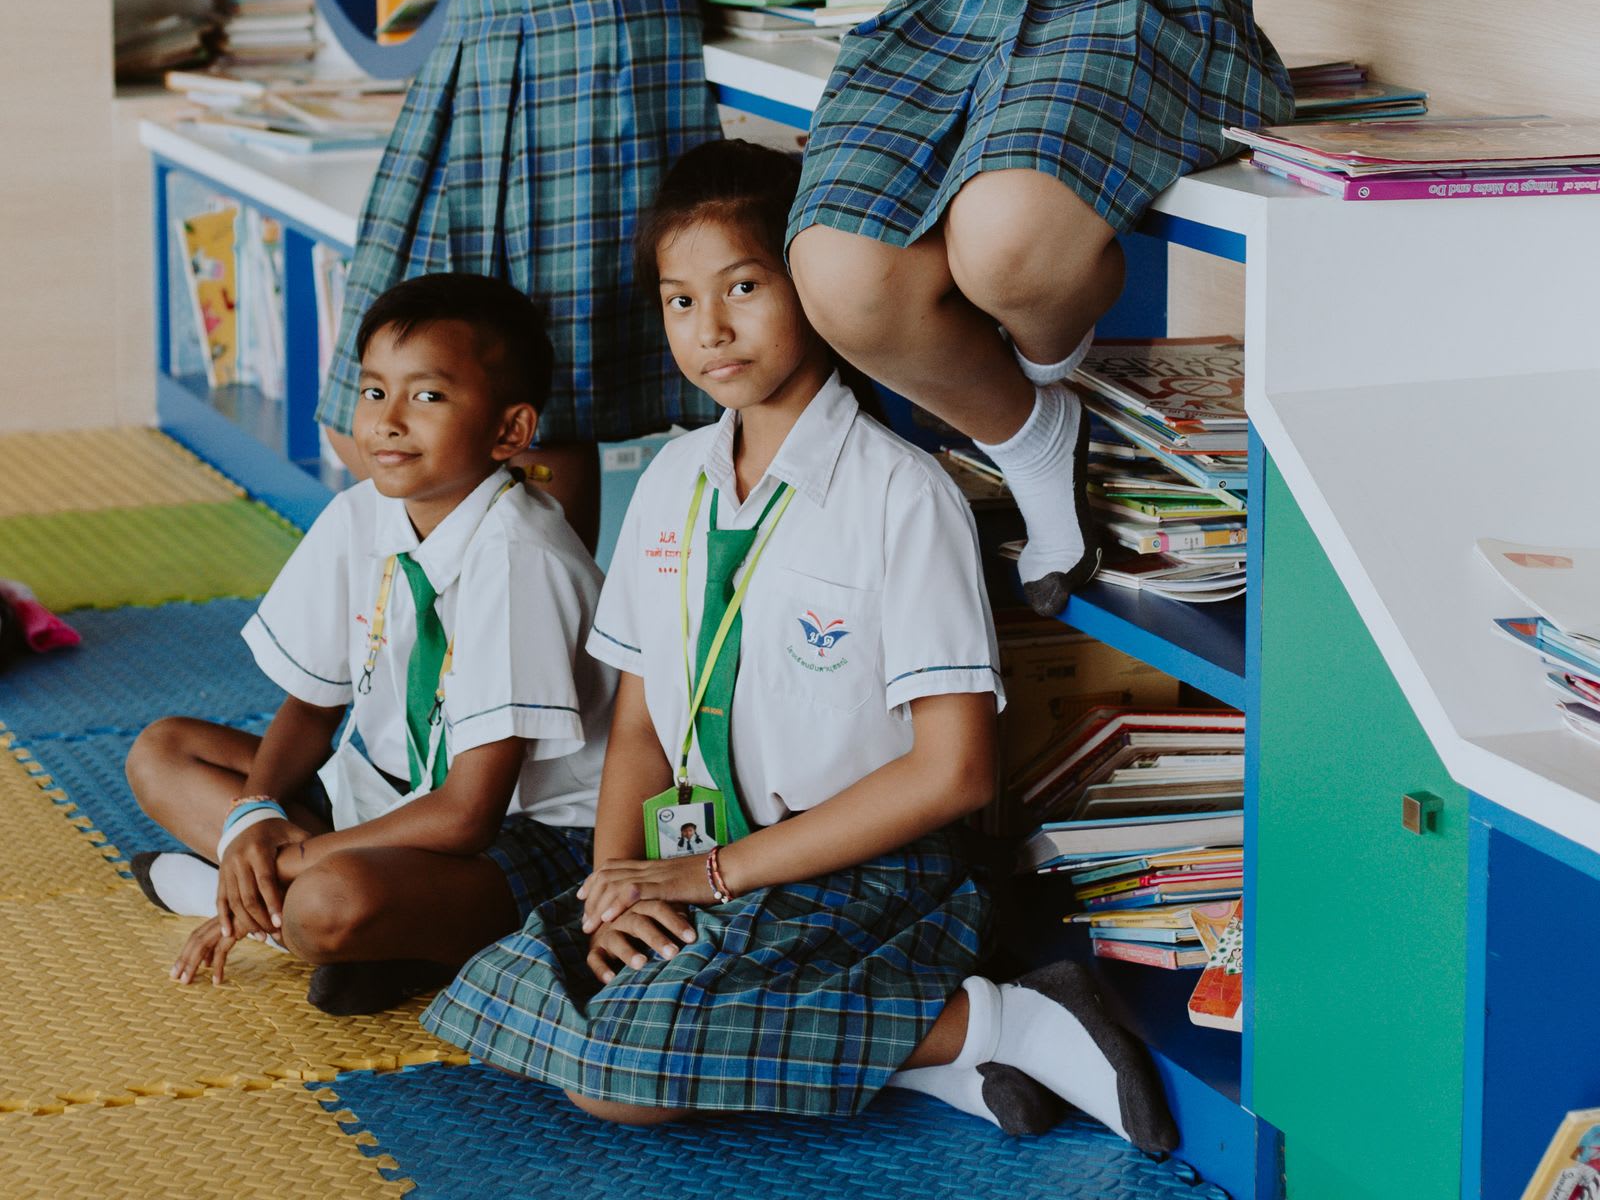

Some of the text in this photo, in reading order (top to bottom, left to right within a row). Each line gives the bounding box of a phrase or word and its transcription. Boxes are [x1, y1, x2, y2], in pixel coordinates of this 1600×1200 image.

[1429, 184, 1447, 196] Do
[1449, 183, 1471, 196] and
[1473, 183, 1505, 195] Make
[1506, 183, 1519, 194] to
[1521, 180, 1559, 193] Things
[1562, 182, 1574, 191] of
